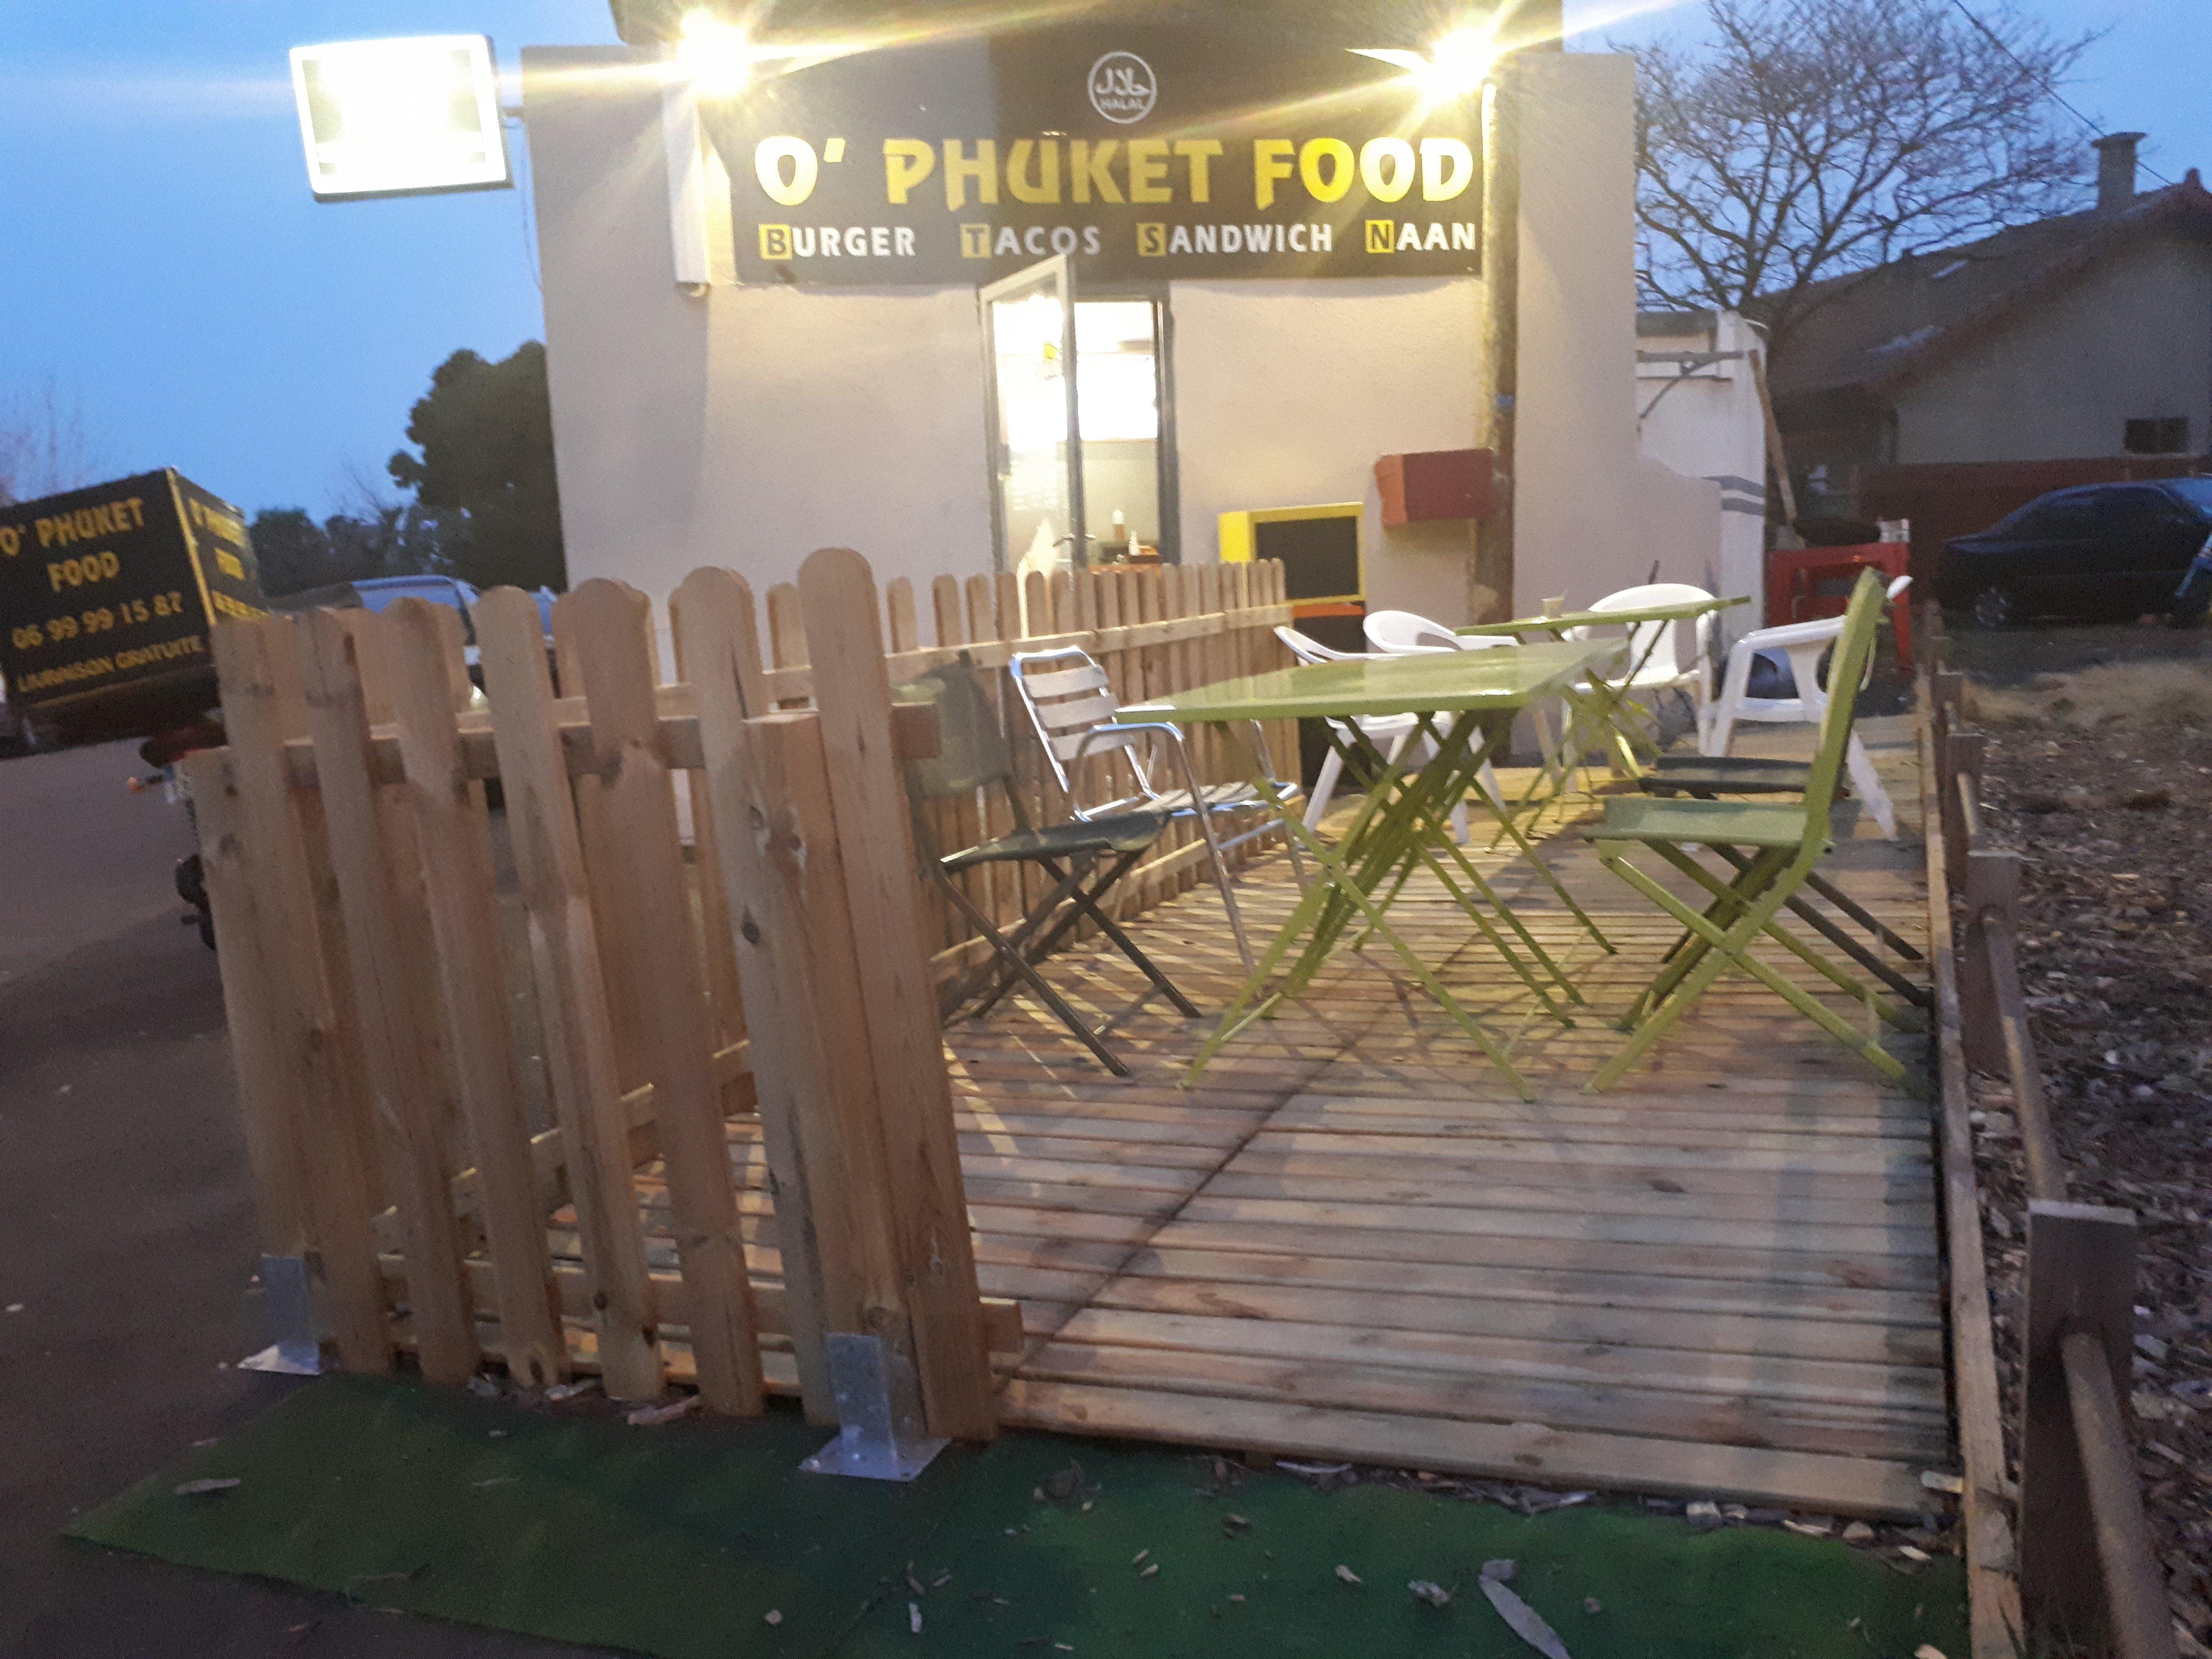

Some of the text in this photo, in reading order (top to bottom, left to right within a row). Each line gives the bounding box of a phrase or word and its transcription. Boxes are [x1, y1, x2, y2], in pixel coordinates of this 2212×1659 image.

[755, 135, 1473, 212] O' PHUKET FOOD
[758, 219, 1476, 260] BURGER TACOS SANDWICH NAAN
[35, 497, 144, 548] PHUKET
[48, 552, 120, 591] FOOD
[12, 625, 44, 649] 06
[120, 599, 150, 624] 15
